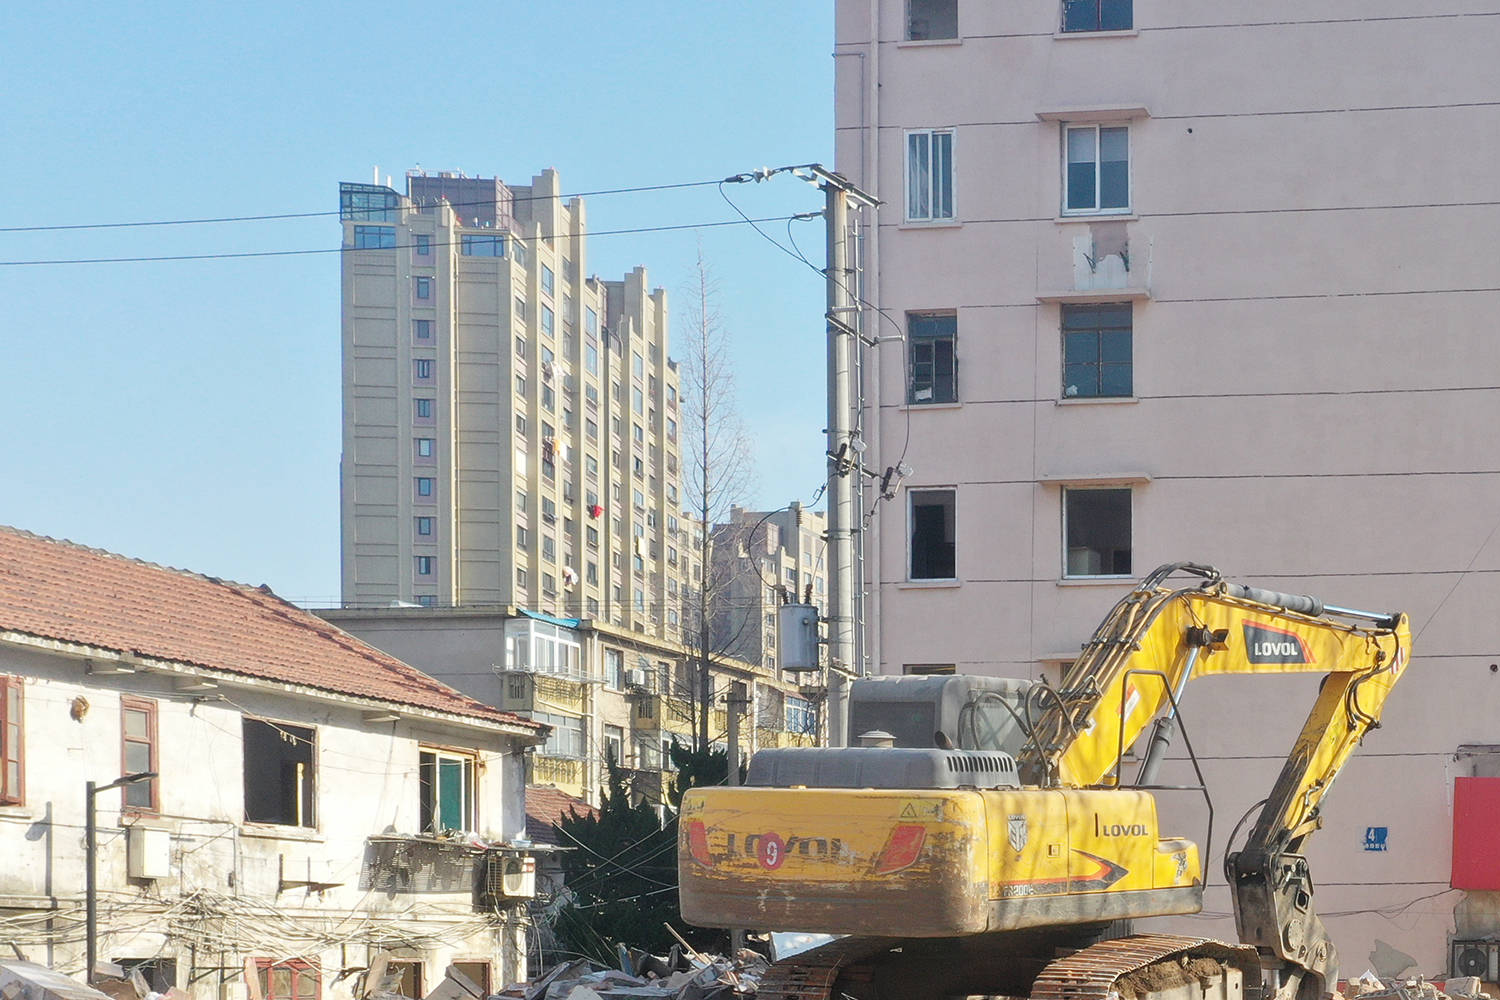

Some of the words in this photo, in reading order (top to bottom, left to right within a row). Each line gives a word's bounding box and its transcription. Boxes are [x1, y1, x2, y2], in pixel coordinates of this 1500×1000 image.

[1254, 642, 1298, 657] LOVOL
[1103, 824, 1149, 837] LOVOL
[766, 841, 777, 866] 9
